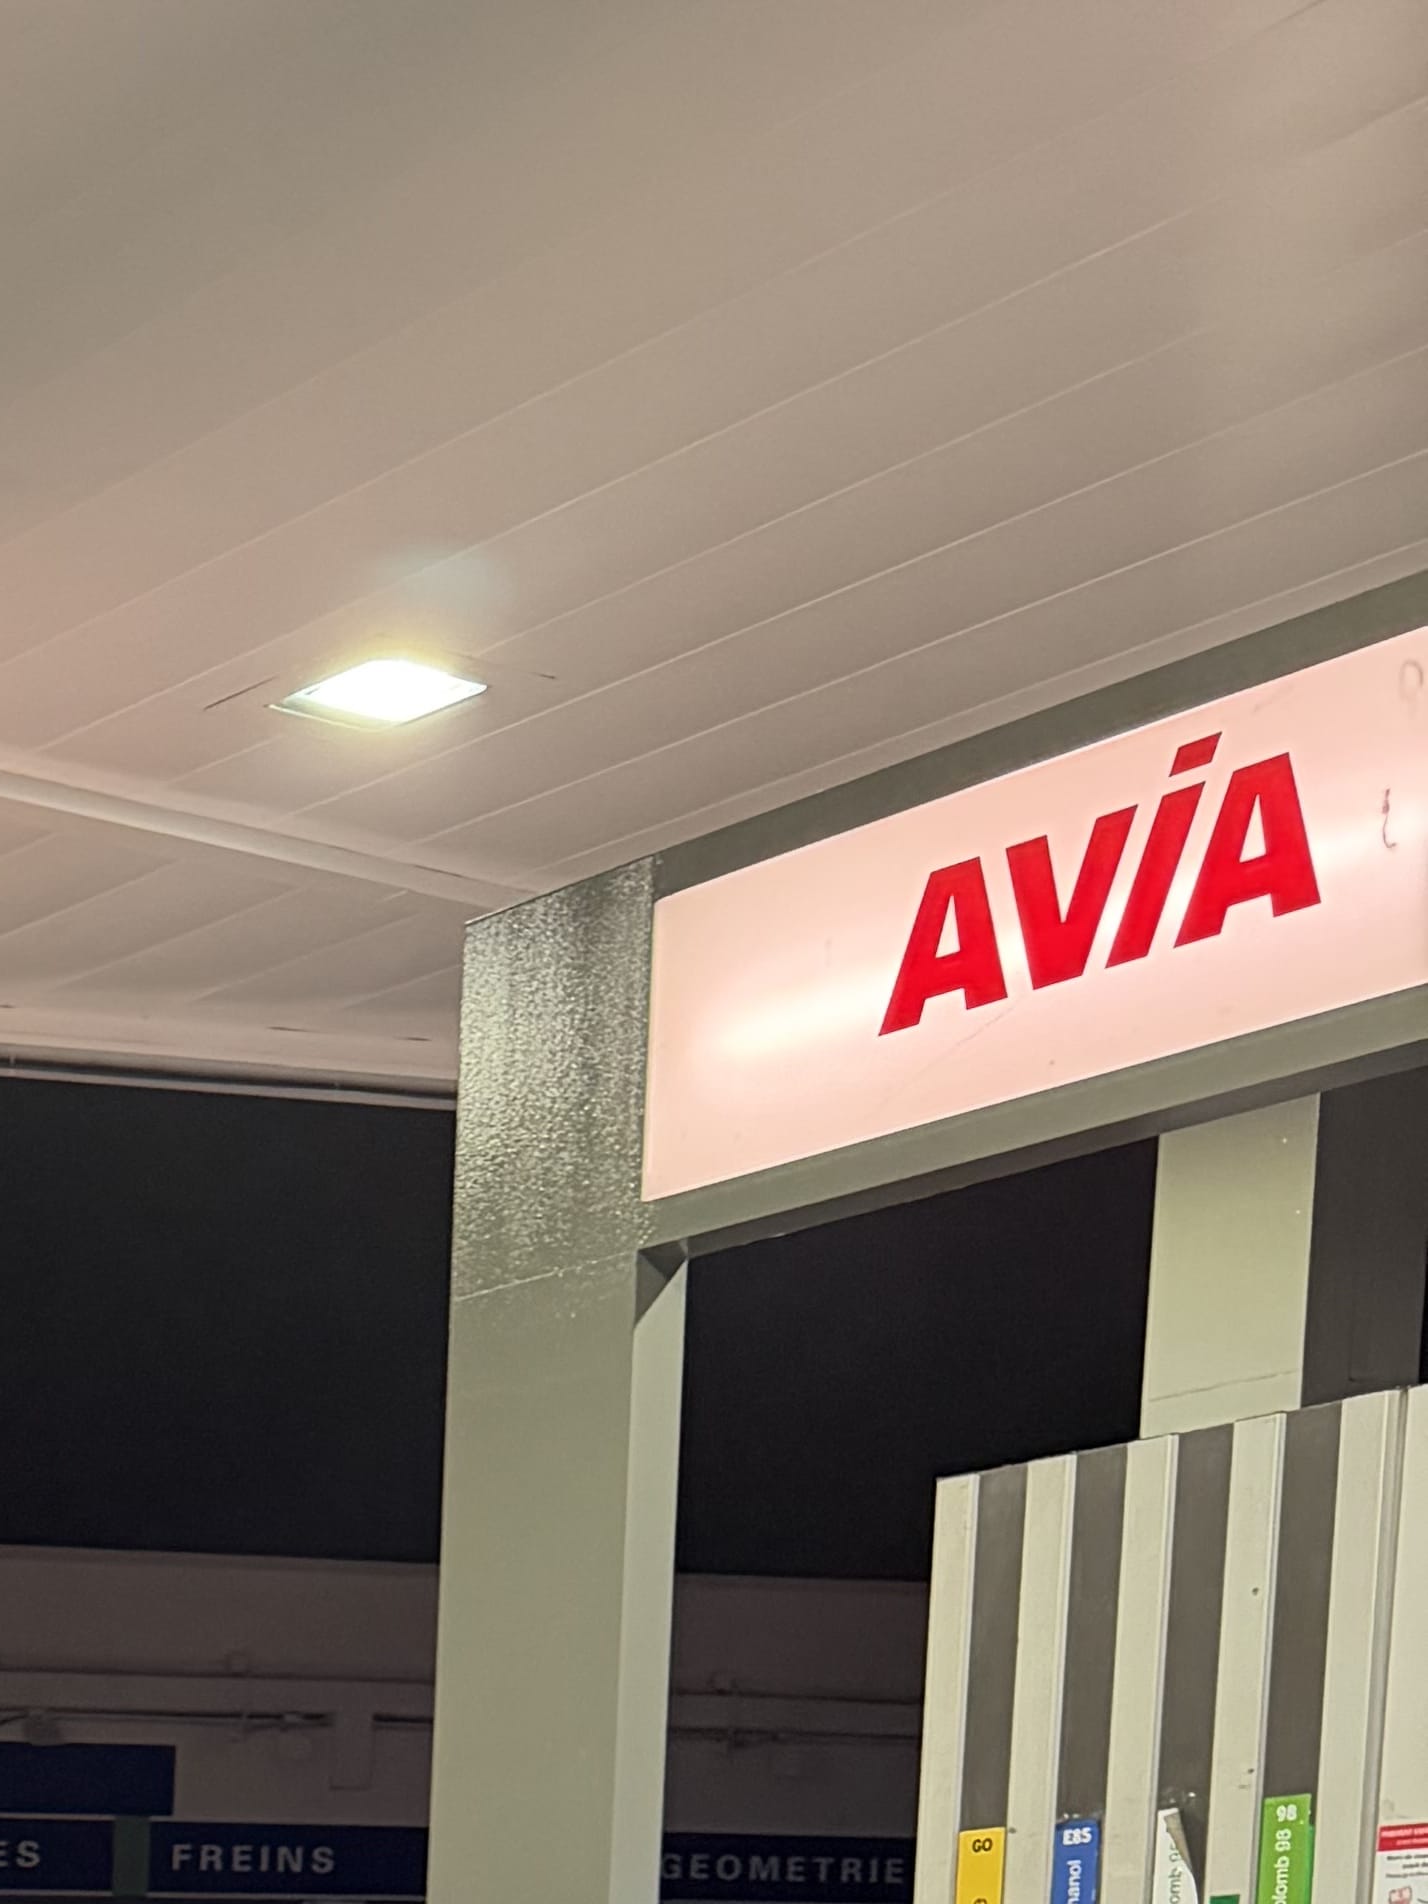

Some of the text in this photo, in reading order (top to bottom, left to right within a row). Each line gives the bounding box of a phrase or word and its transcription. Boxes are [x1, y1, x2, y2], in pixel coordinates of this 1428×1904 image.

[877, 730, 1322, 1037] AVIA
[1276, 1803, 1298, 1822] 98
[972, 1837, 993, 1853] GO
[1062, 1826, 1092, 1846] E85
[172, 1843, 336, 1875] FREINS
[660, 1853, 906, 1885] GEOMETRIE
